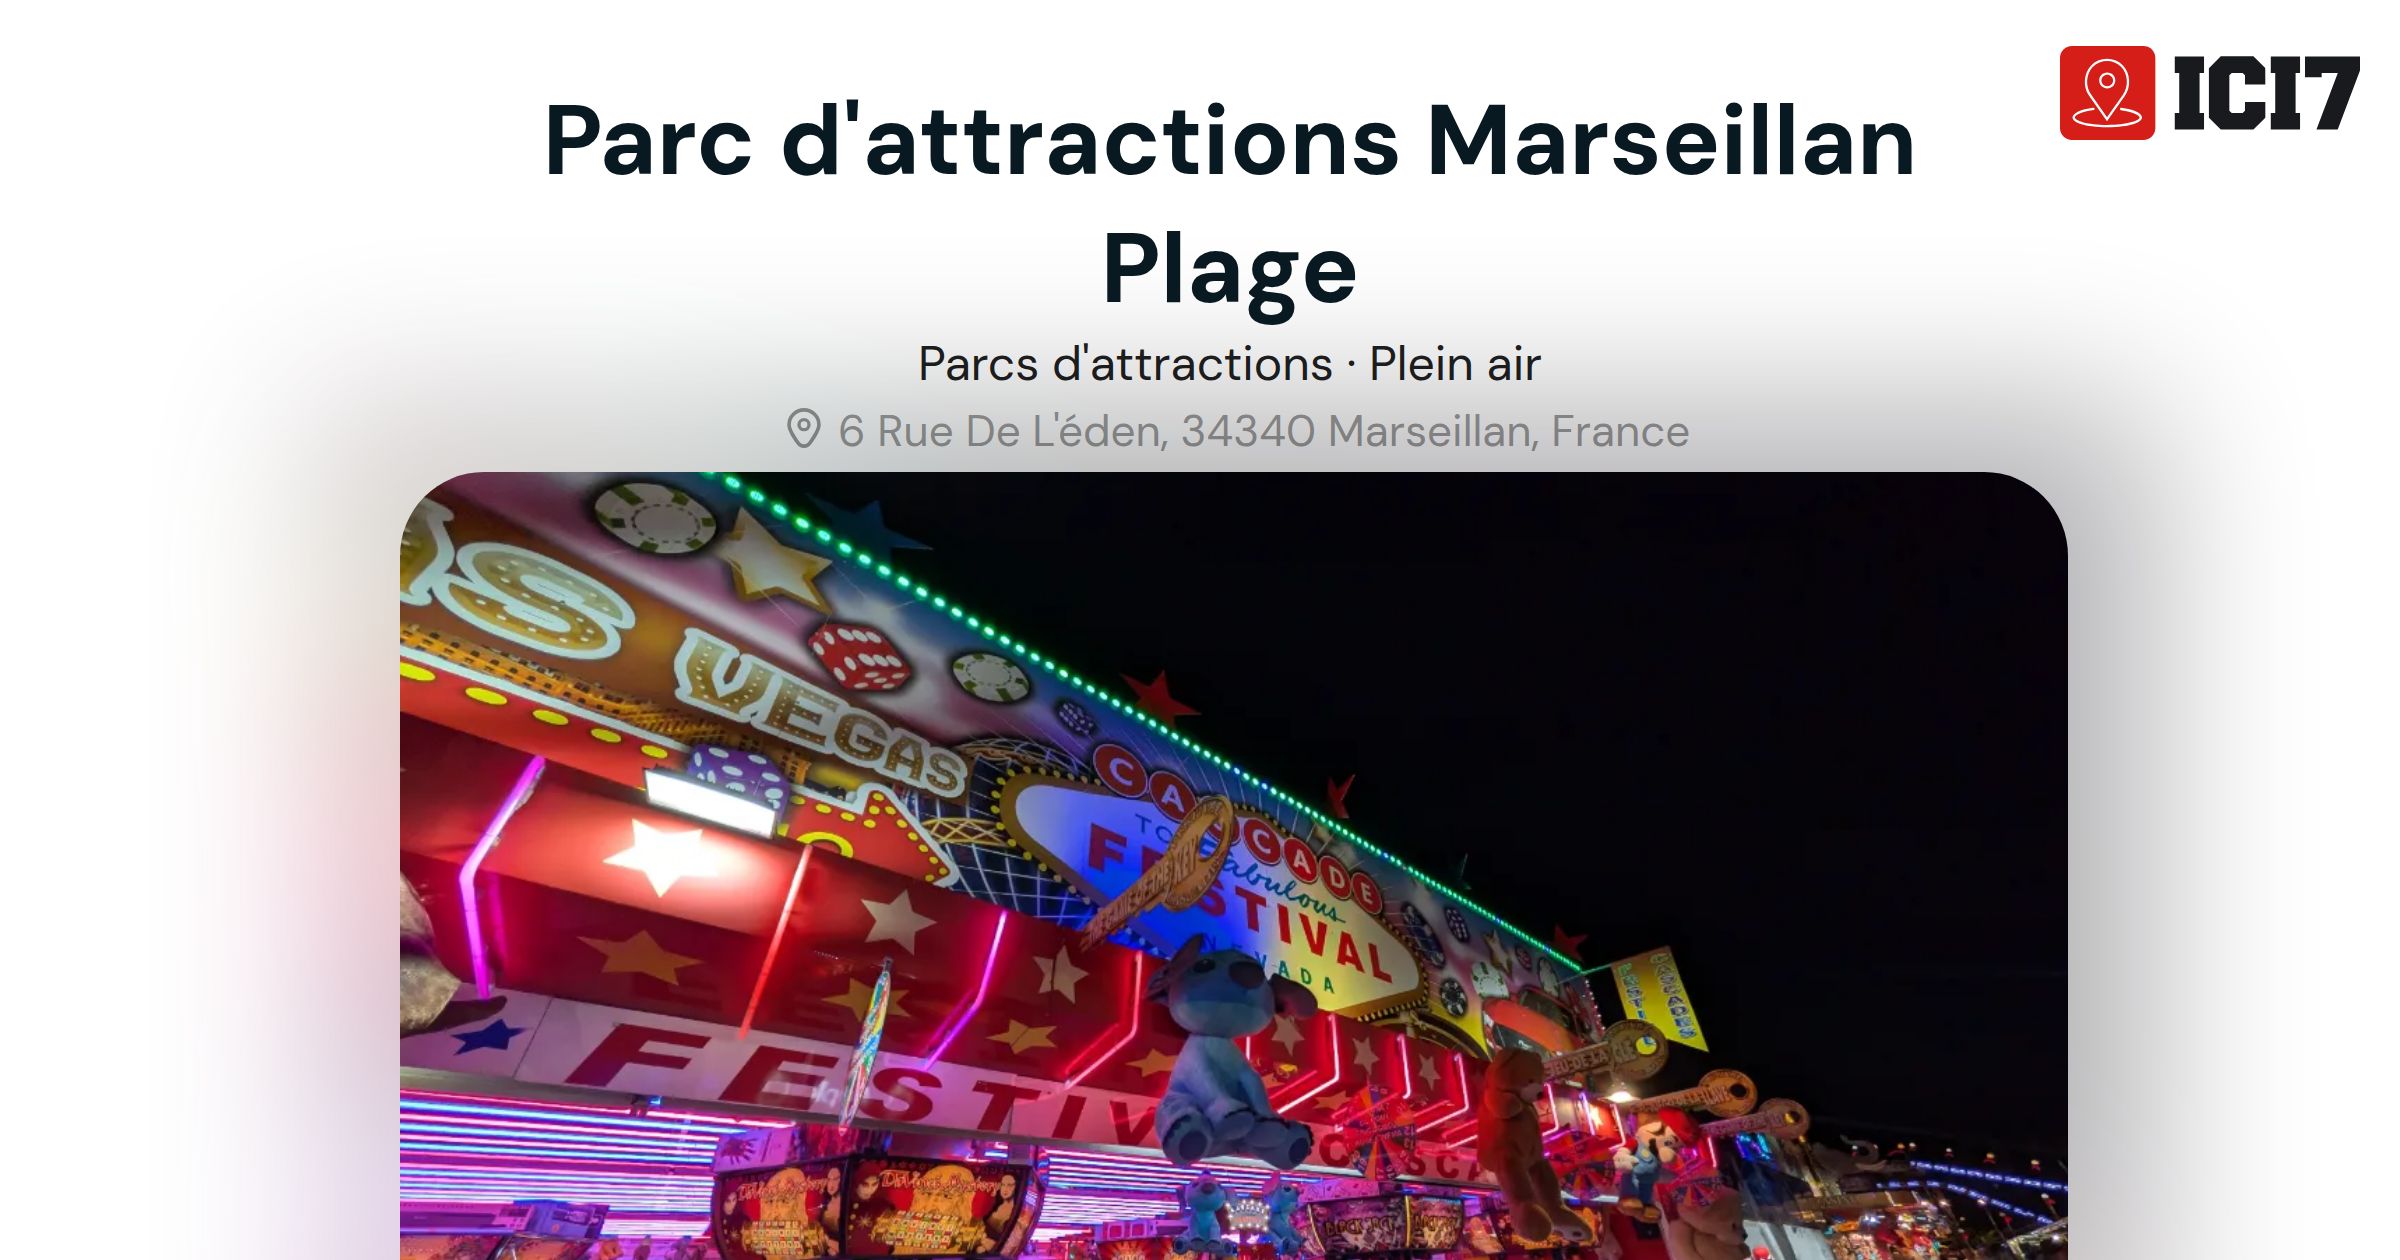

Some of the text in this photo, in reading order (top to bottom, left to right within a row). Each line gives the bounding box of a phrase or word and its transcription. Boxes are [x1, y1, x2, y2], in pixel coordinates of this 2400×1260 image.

[674, 627, 969, 798] VEGAS
[1107, 754, 1378, 909] CACADE
[1203, 933, 1336, 995] NVADA
[1649, 952, 1697, 1039] CASCADES
[566, 1023, 1157, 1147] FESTIV
